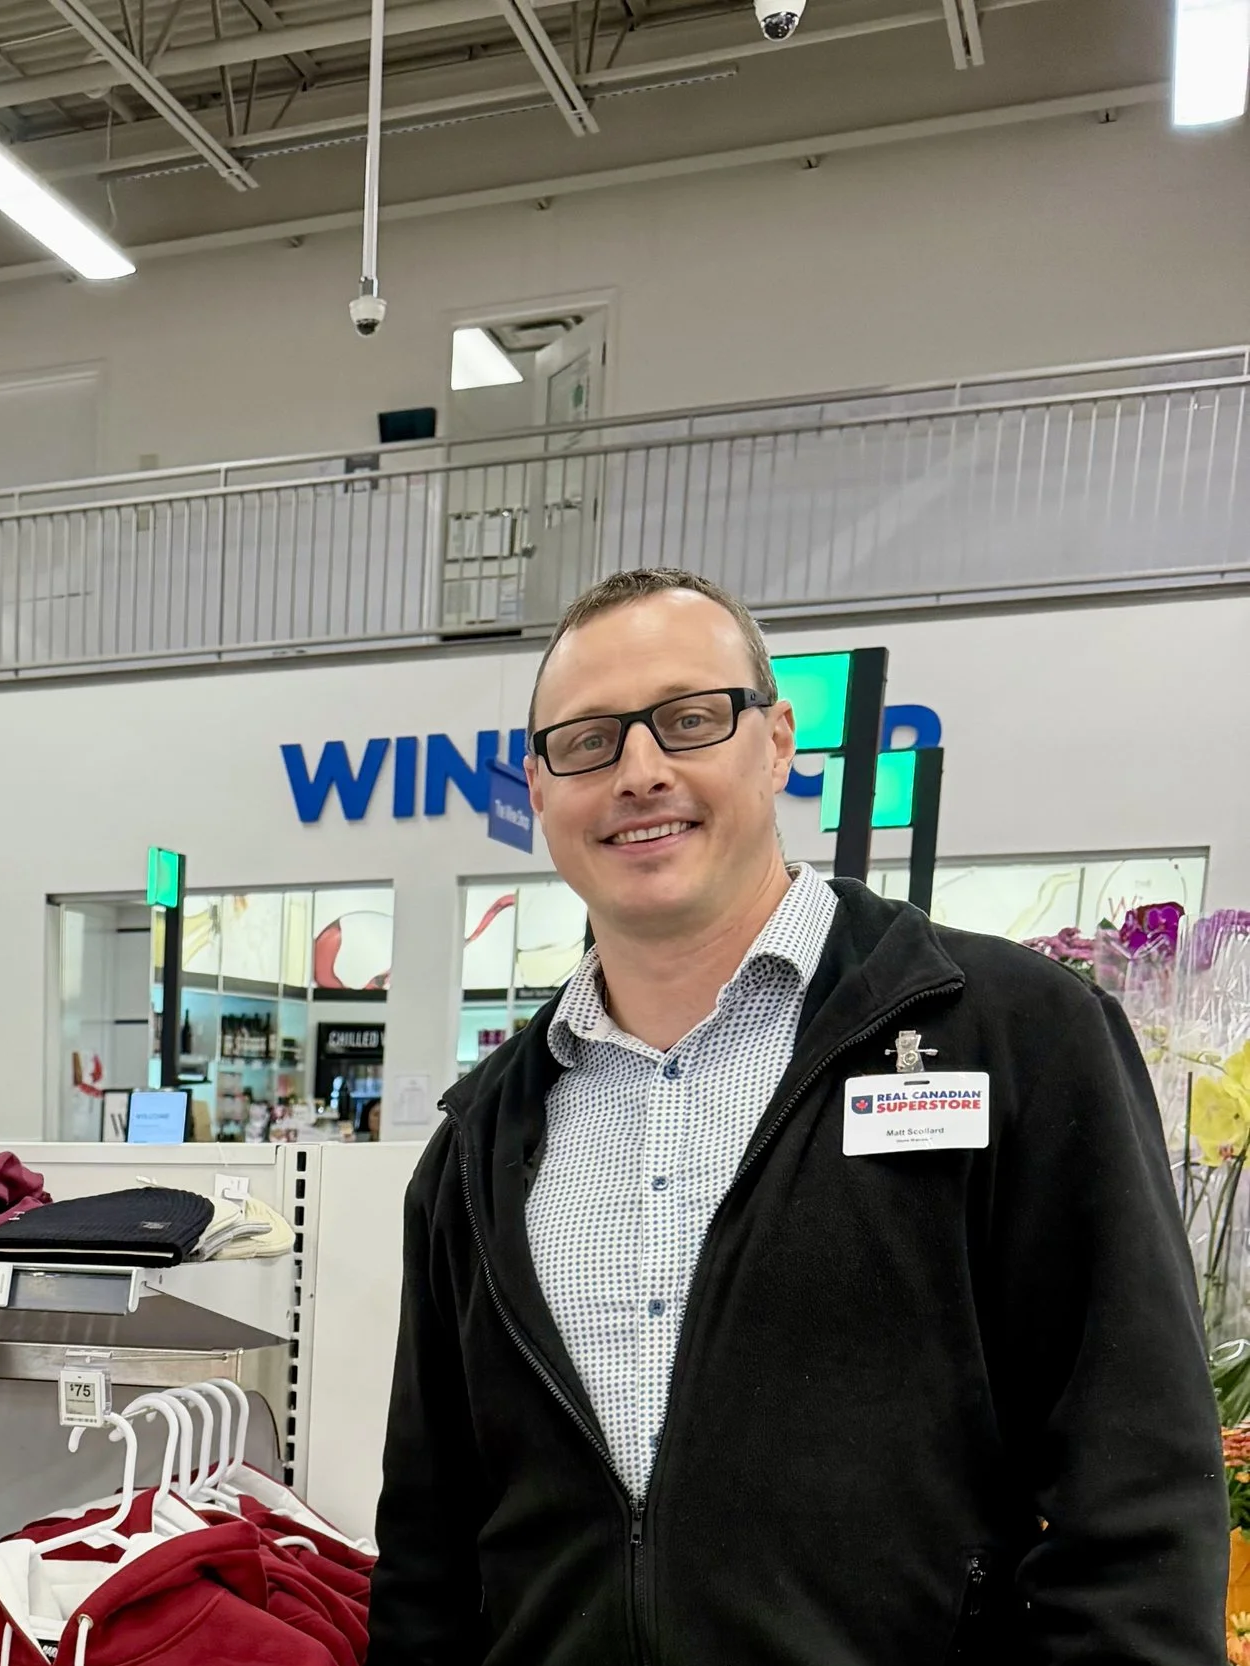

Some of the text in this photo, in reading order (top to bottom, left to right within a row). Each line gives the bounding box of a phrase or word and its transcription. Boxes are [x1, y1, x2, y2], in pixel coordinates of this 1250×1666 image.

[280, 729, 526, 823] WIN
[328, 1030, 380, 1048] CHILLED
[876, 1090, 981, 1102] REAL CANADIAN
[876, 1099, 982, 1114] SUPERSTORE
[886, 1129, 906, 1137] Matt
[69, 1383, 91, 1397] $75
